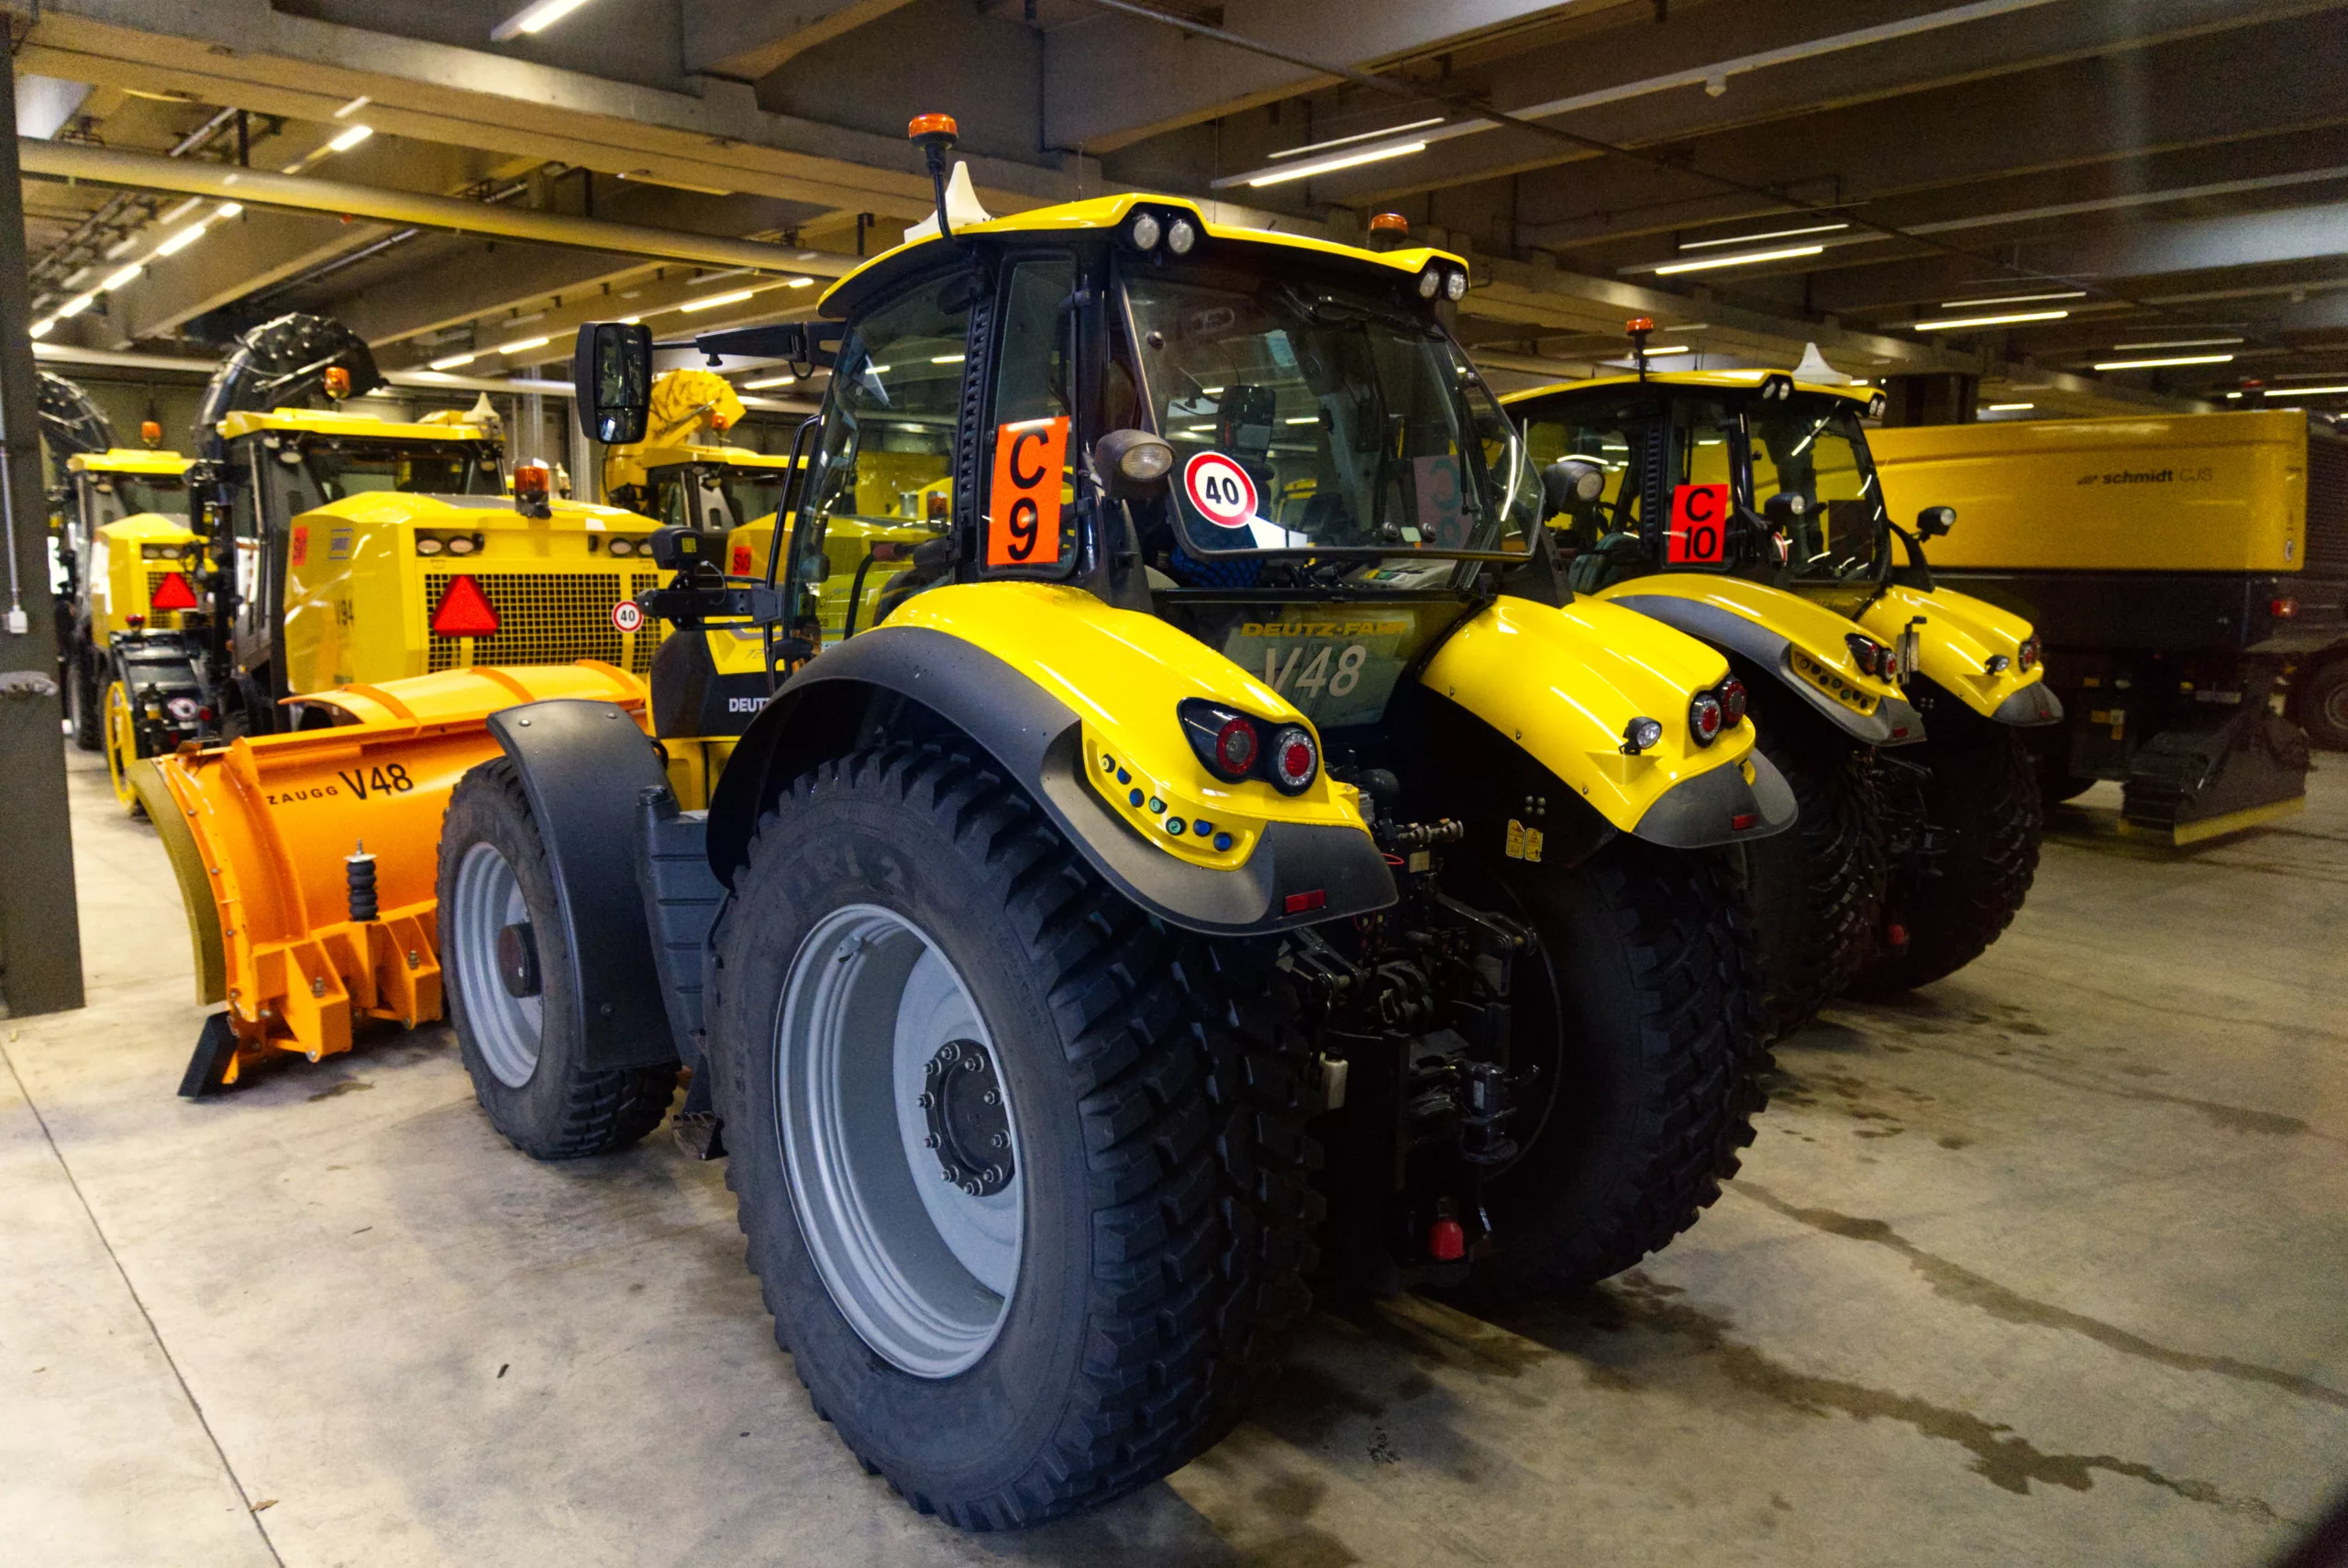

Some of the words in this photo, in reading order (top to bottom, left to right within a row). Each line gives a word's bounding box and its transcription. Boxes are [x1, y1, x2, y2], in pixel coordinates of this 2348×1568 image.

[1009, 425, 1049, 490] C
[1205, 476, 1239, 505] 40
[2102, 469, 2174, 484] schmidt
[1685, 487, 1715, 522] C
[1007, 497, 1038, 561] 9
[1684, 525, 1716, 559] 10
[620, 610, 636, 622] 40
[1264, 645, 1367, 698] V48
[728, 697, 770, 712] DEUT
[266, 786, 338, 805] ZAUGG
[338, 764, 414, 801] V48
